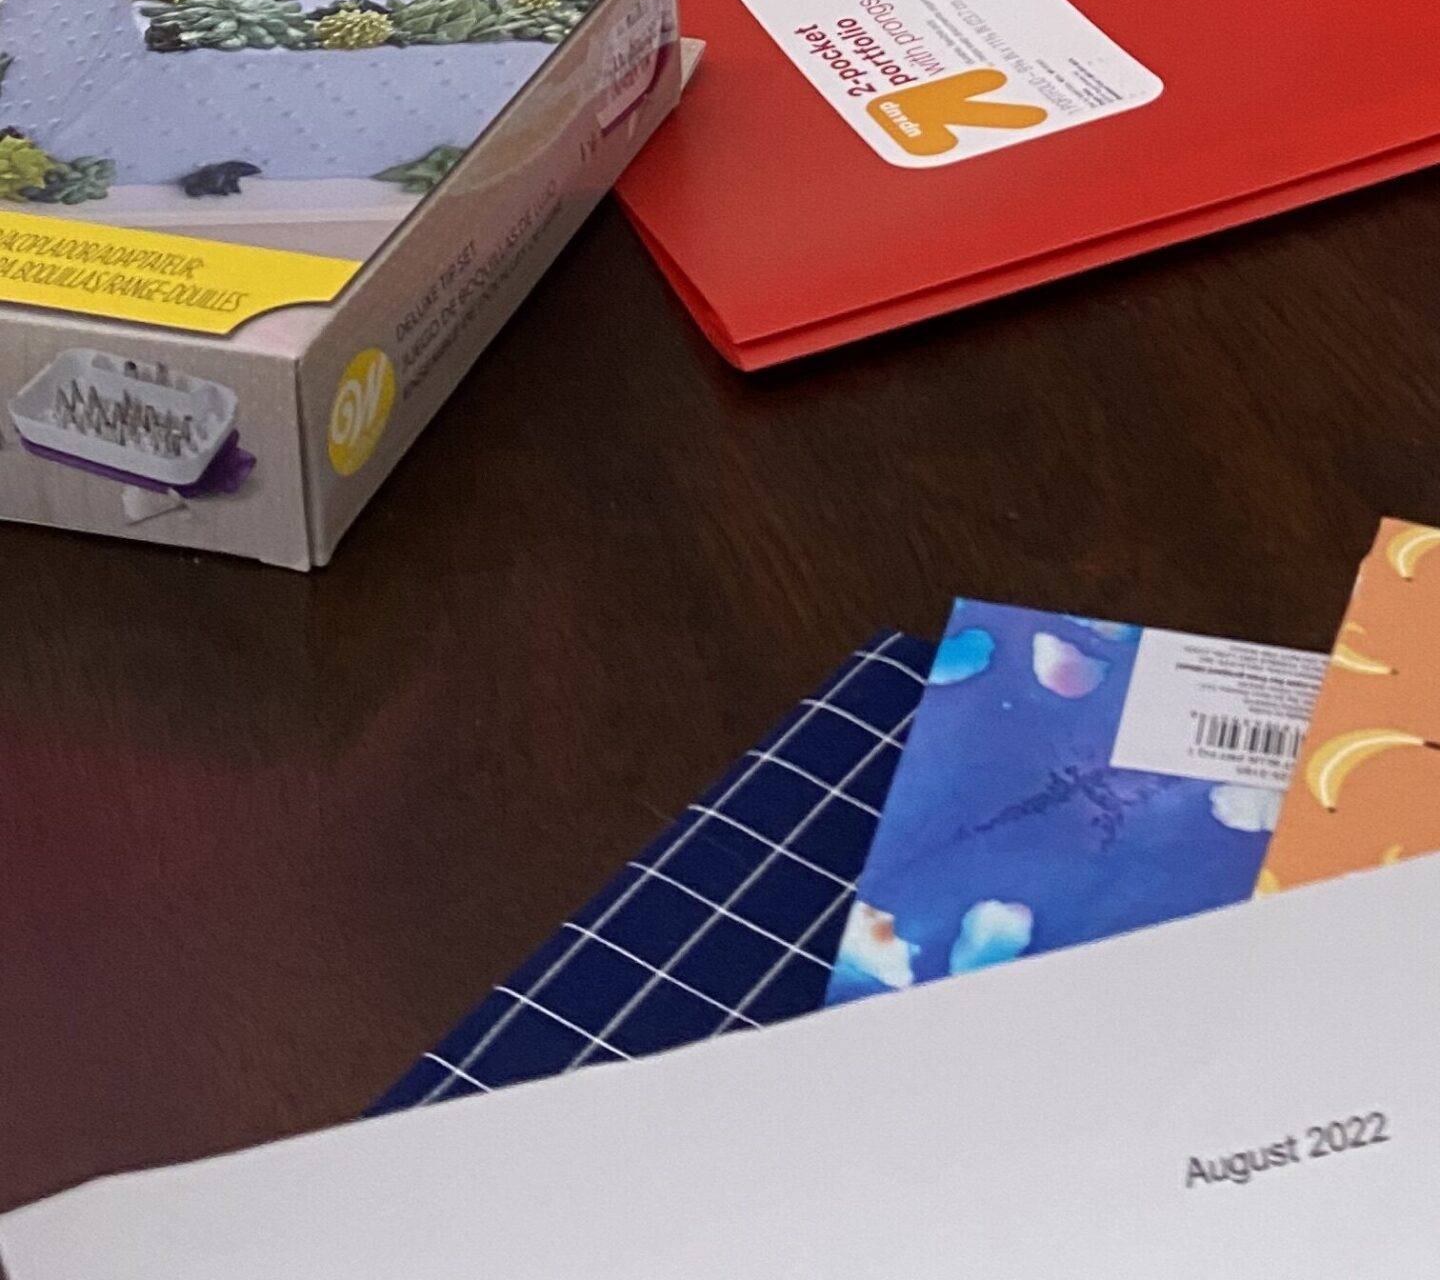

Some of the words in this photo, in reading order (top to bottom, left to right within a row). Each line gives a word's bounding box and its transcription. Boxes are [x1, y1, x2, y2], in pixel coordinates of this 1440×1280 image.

[794, 24, 877, 97] 2-pocket
[837, 18, 919, 86] portfolio
[905, 44, 945, 76] with
[1186, 1135, 1301, 1189] August
[1306, 1111, 1392, 1159] 2022
